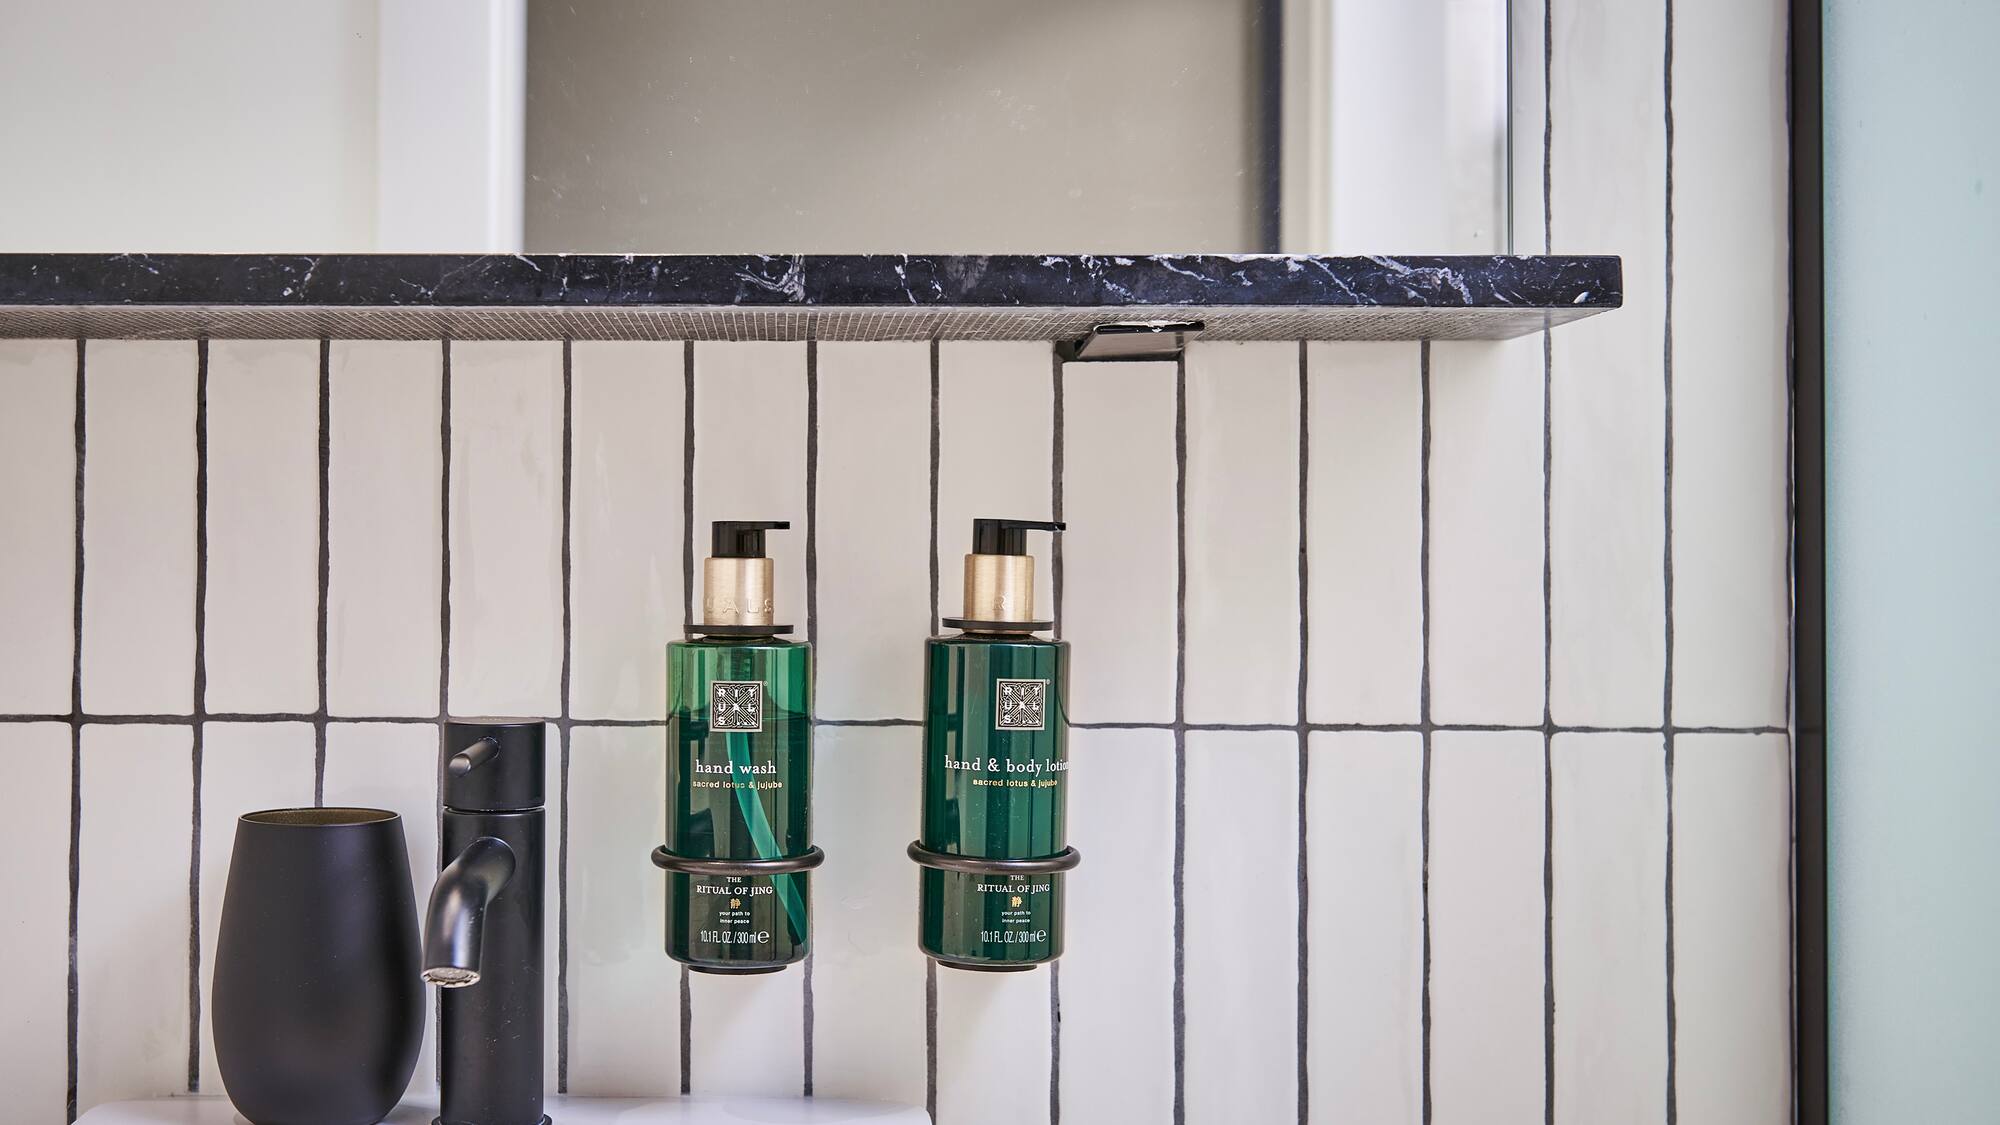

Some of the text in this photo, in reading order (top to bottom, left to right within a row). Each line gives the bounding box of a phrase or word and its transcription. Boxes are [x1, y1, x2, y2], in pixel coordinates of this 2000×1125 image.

[695, 759, 777, 774] hand wash
[944, 755, 981, 771] hand
[987, 757, 1001, 772] &
[1006, 758, 1042, 777] body
[692, 781, 720, 789] sacred
[748, 781, 755, 789] &
[757, 781, 783, 790] jujube
[973, 779, 1003, 787] sacred
[1006, 779, 1028, 787] lotus
[1038, 780, 1057, 788] jujube
[696, 885, 773, 897] RITUAL OF JING
[977, 883, 1050, 895] RITUAL OF JING
